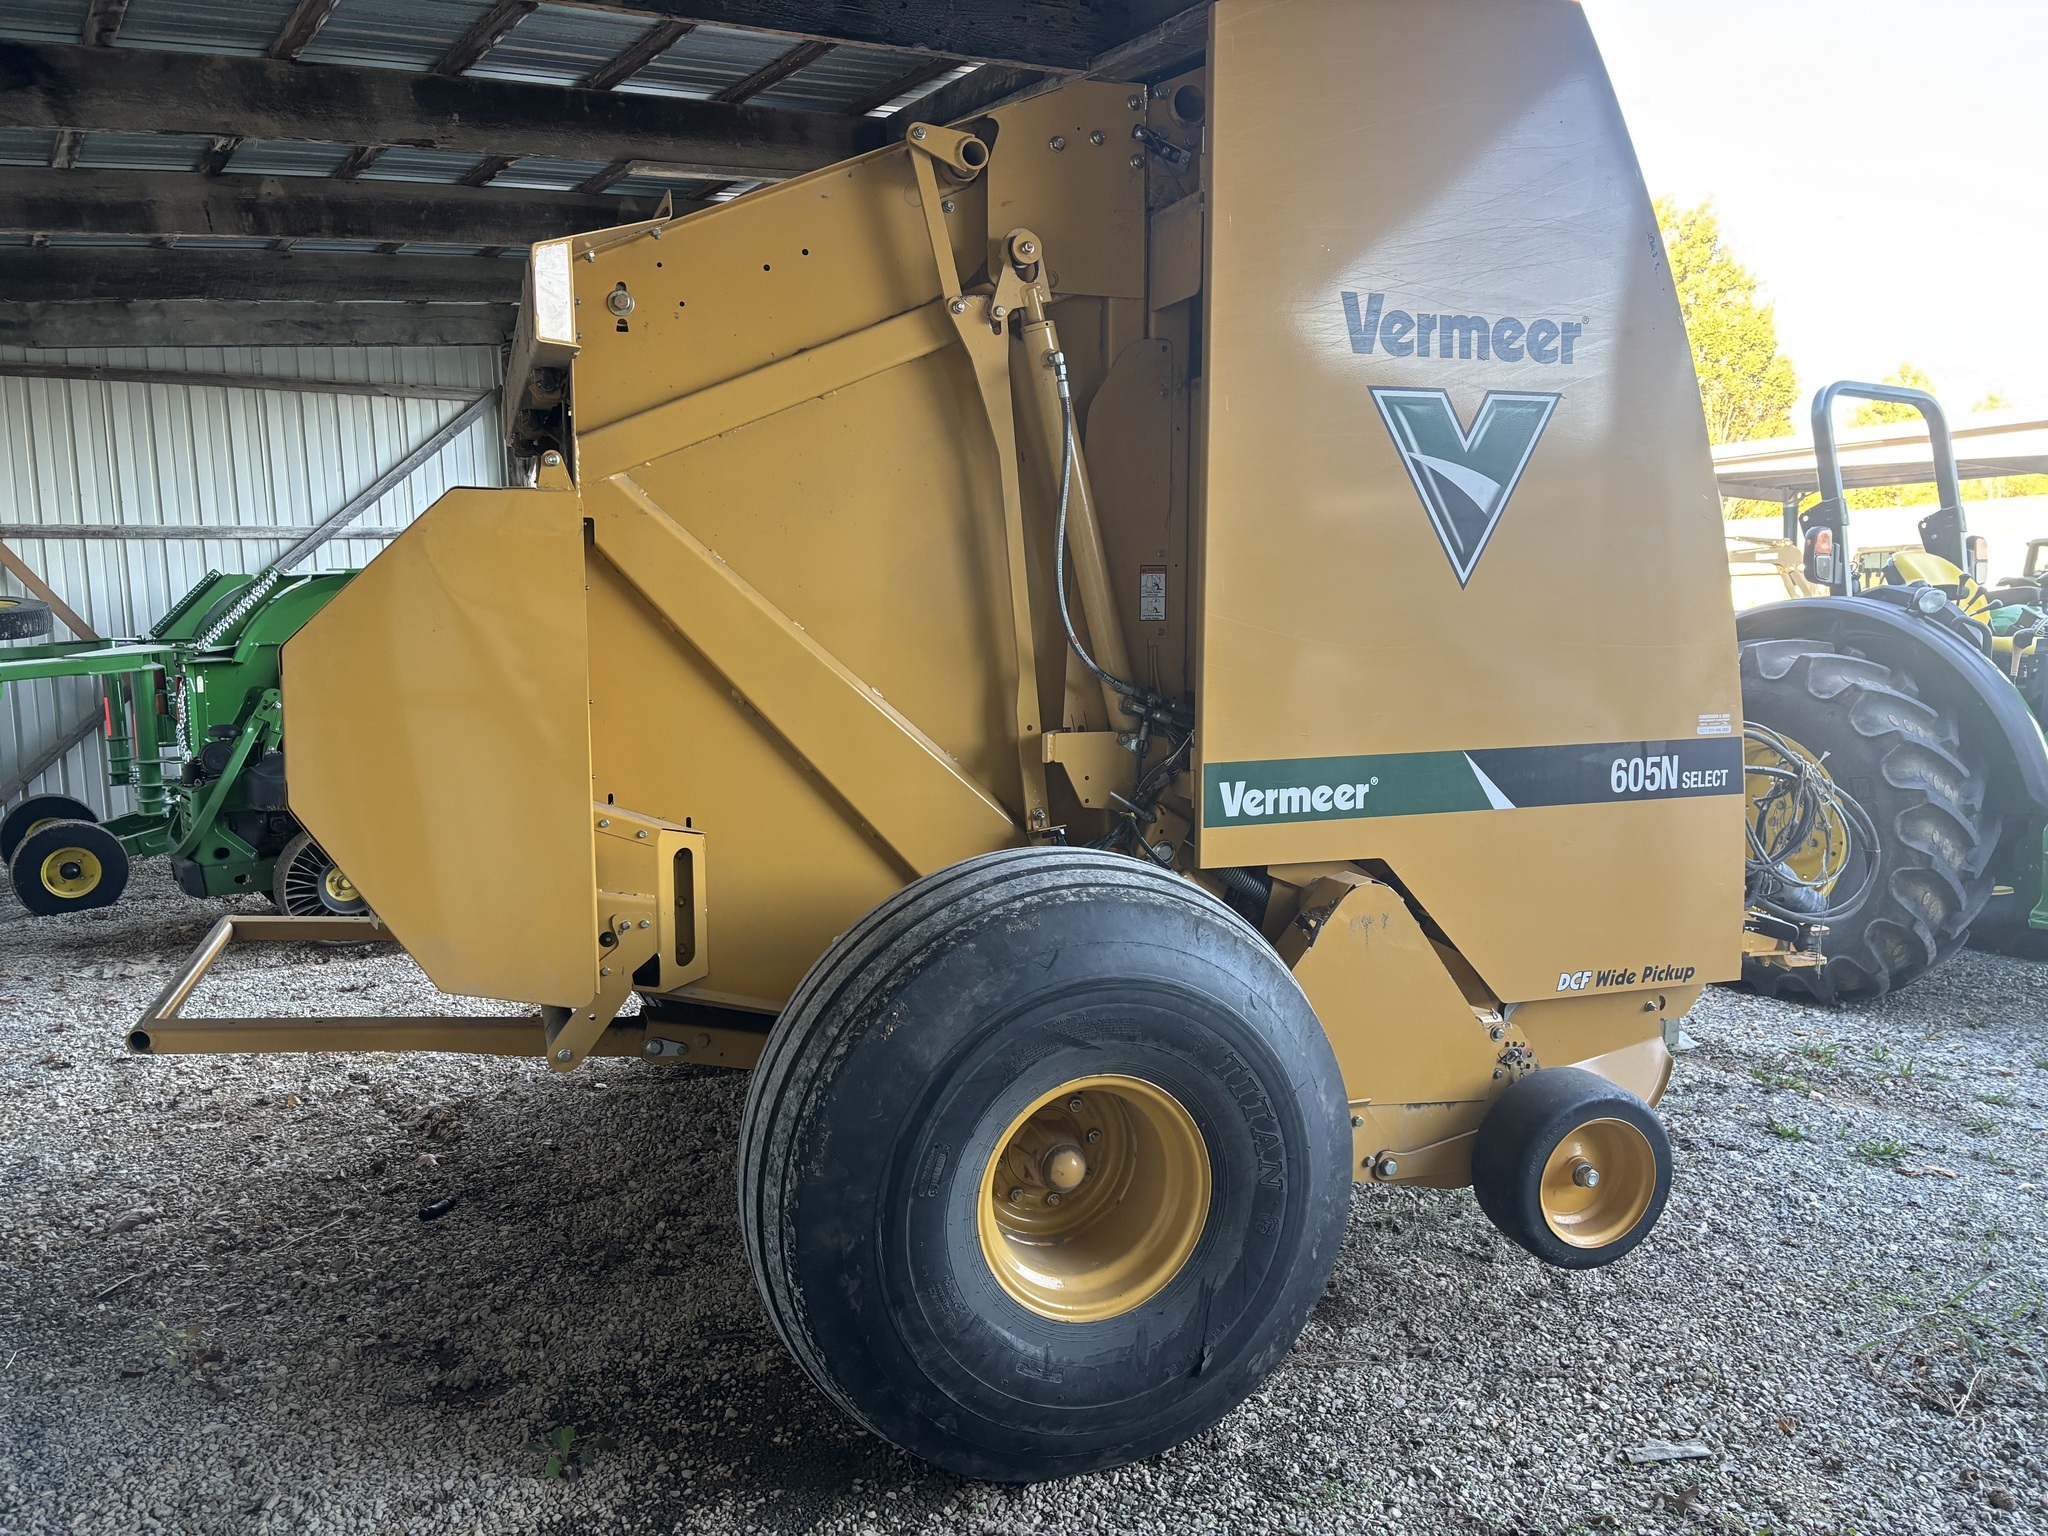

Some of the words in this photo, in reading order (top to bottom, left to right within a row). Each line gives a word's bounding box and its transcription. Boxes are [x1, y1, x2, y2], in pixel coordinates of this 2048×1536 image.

[1610, 755, 1679, 793] 605N
[1682, 769, 1729, 789] SELECT
[1556, 969, 1593, 992] DCF
[1595, 968, 1637, 988] Wide
[1641, 964, 1696, 983] Pickup
[1212, 1051, 1284, 1192] TITAN
